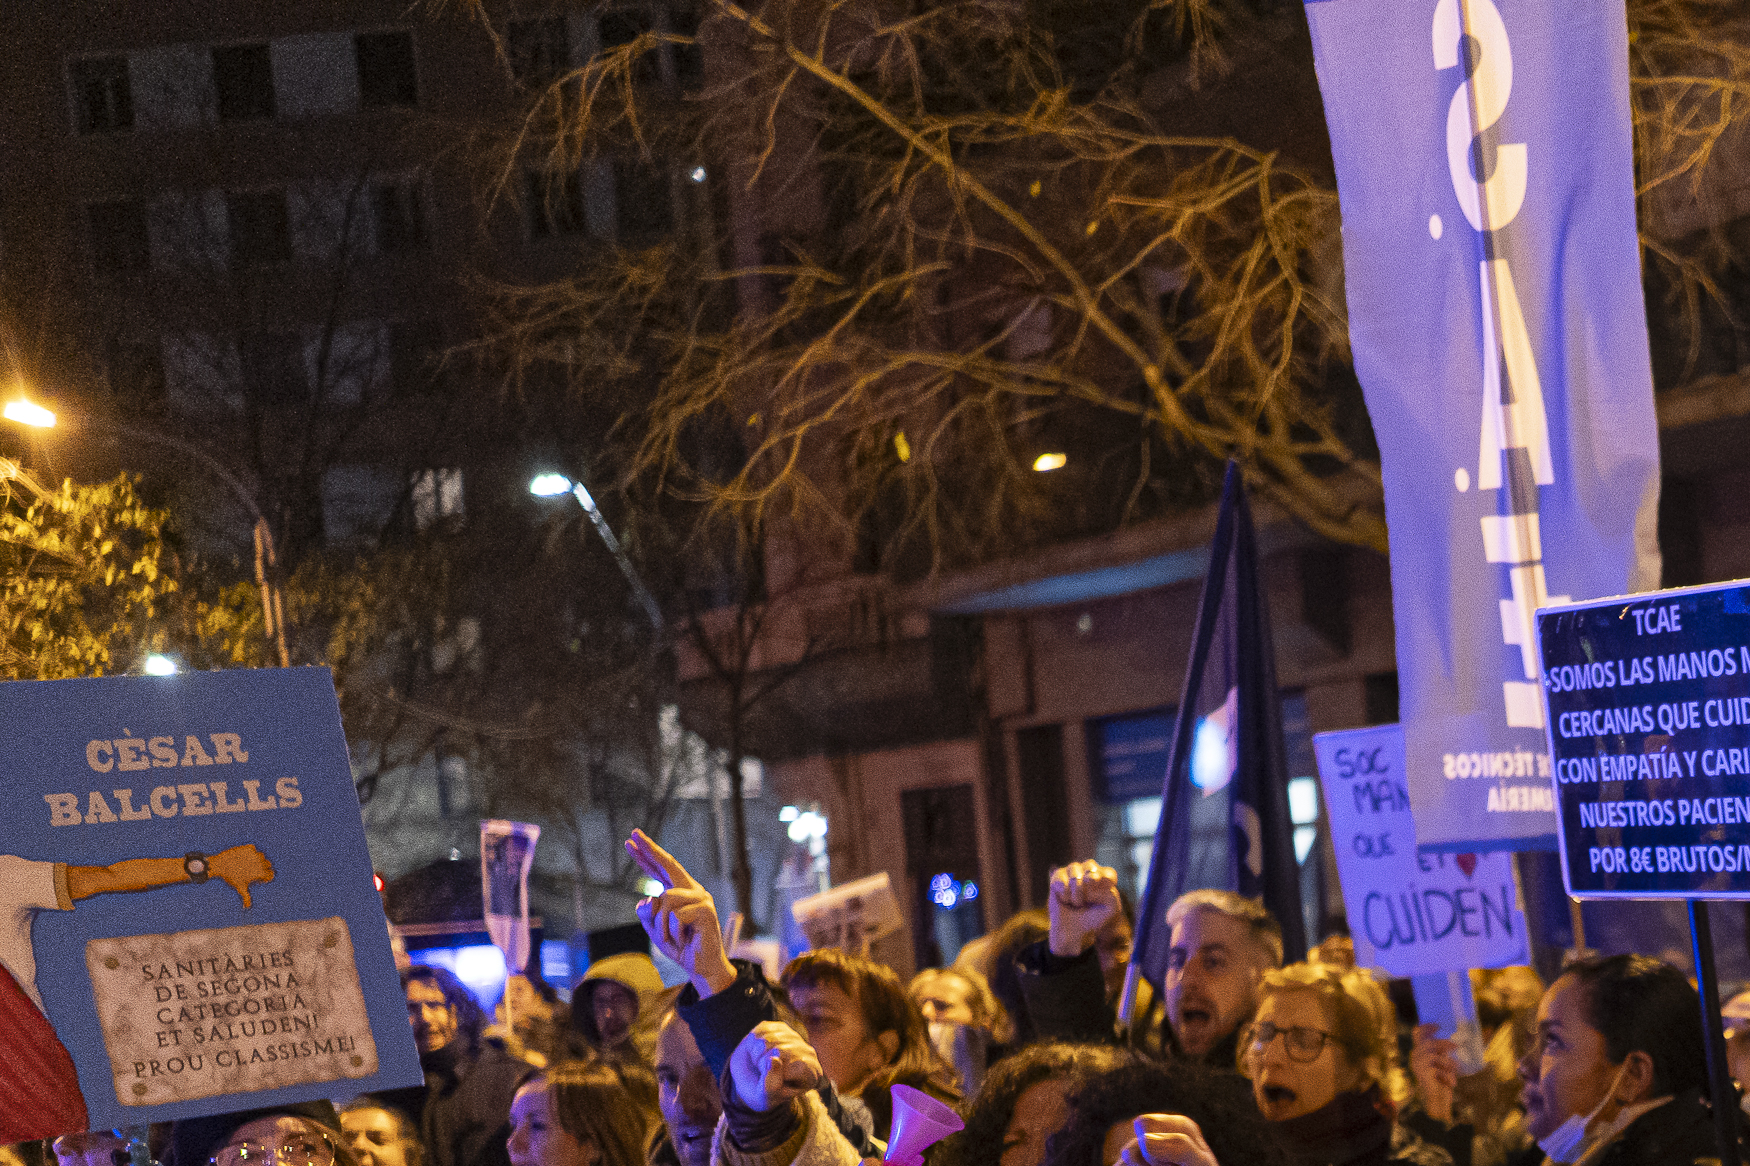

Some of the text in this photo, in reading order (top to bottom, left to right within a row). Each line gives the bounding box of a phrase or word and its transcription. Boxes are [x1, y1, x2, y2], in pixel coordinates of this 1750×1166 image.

[1632, 604, 1681, 635] TCAE
[1550, 661, 1615, 692] SOMOS
[1619, 657, 1654, 686] LAS
[1657, 647, 1737, 682] MANOS
[1559, 706, 1655, 738] CERCANAS
[1657, 702, 1700, 736] QUE
[85, 728, 249, 773] CÈSAR
[1558, 757, 1598, 784] CON
[1600, 745, 1682, 782] EMPATÍA
[1683, 751, 1697, 777] Y
[44, 776, 303, 827] BALCELLS
[1579, 800, 1676, 828] NUESTROS
[1589, 847, 1629, 873] POR
[1630, 847, 1654, 872] 8€
[142, 950, 294, 981] SANITÀRIES
[155, 973, 299, 1002] DE SEGONA
[157, 994, 306, 1024] CATEGORIA
[155, 1014, 319, 1047] ET SALUDEN!
[132, 1036, 355, 1077] PROU CLASSISME!
